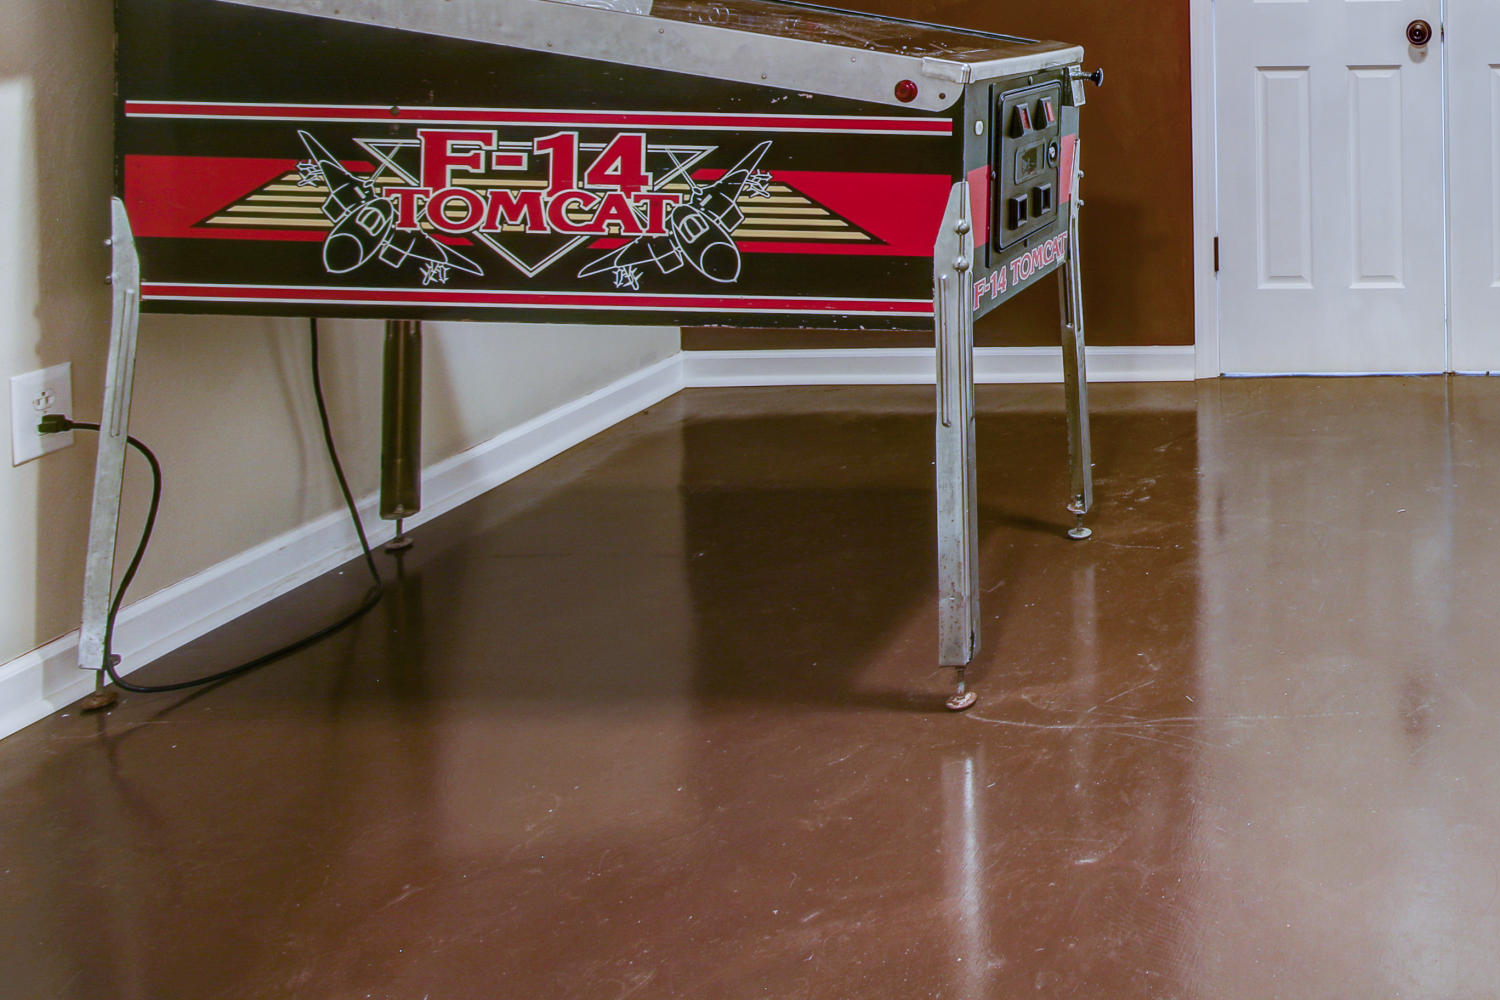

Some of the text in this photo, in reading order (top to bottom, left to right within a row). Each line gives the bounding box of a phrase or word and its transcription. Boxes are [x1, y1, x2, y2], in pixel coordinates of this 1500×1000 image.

[417, 128, 654, 197] F-14
[383, 186, 681, 236] TOMCAT
[973, 232, 1068, 312] F-14 TOMCAT
